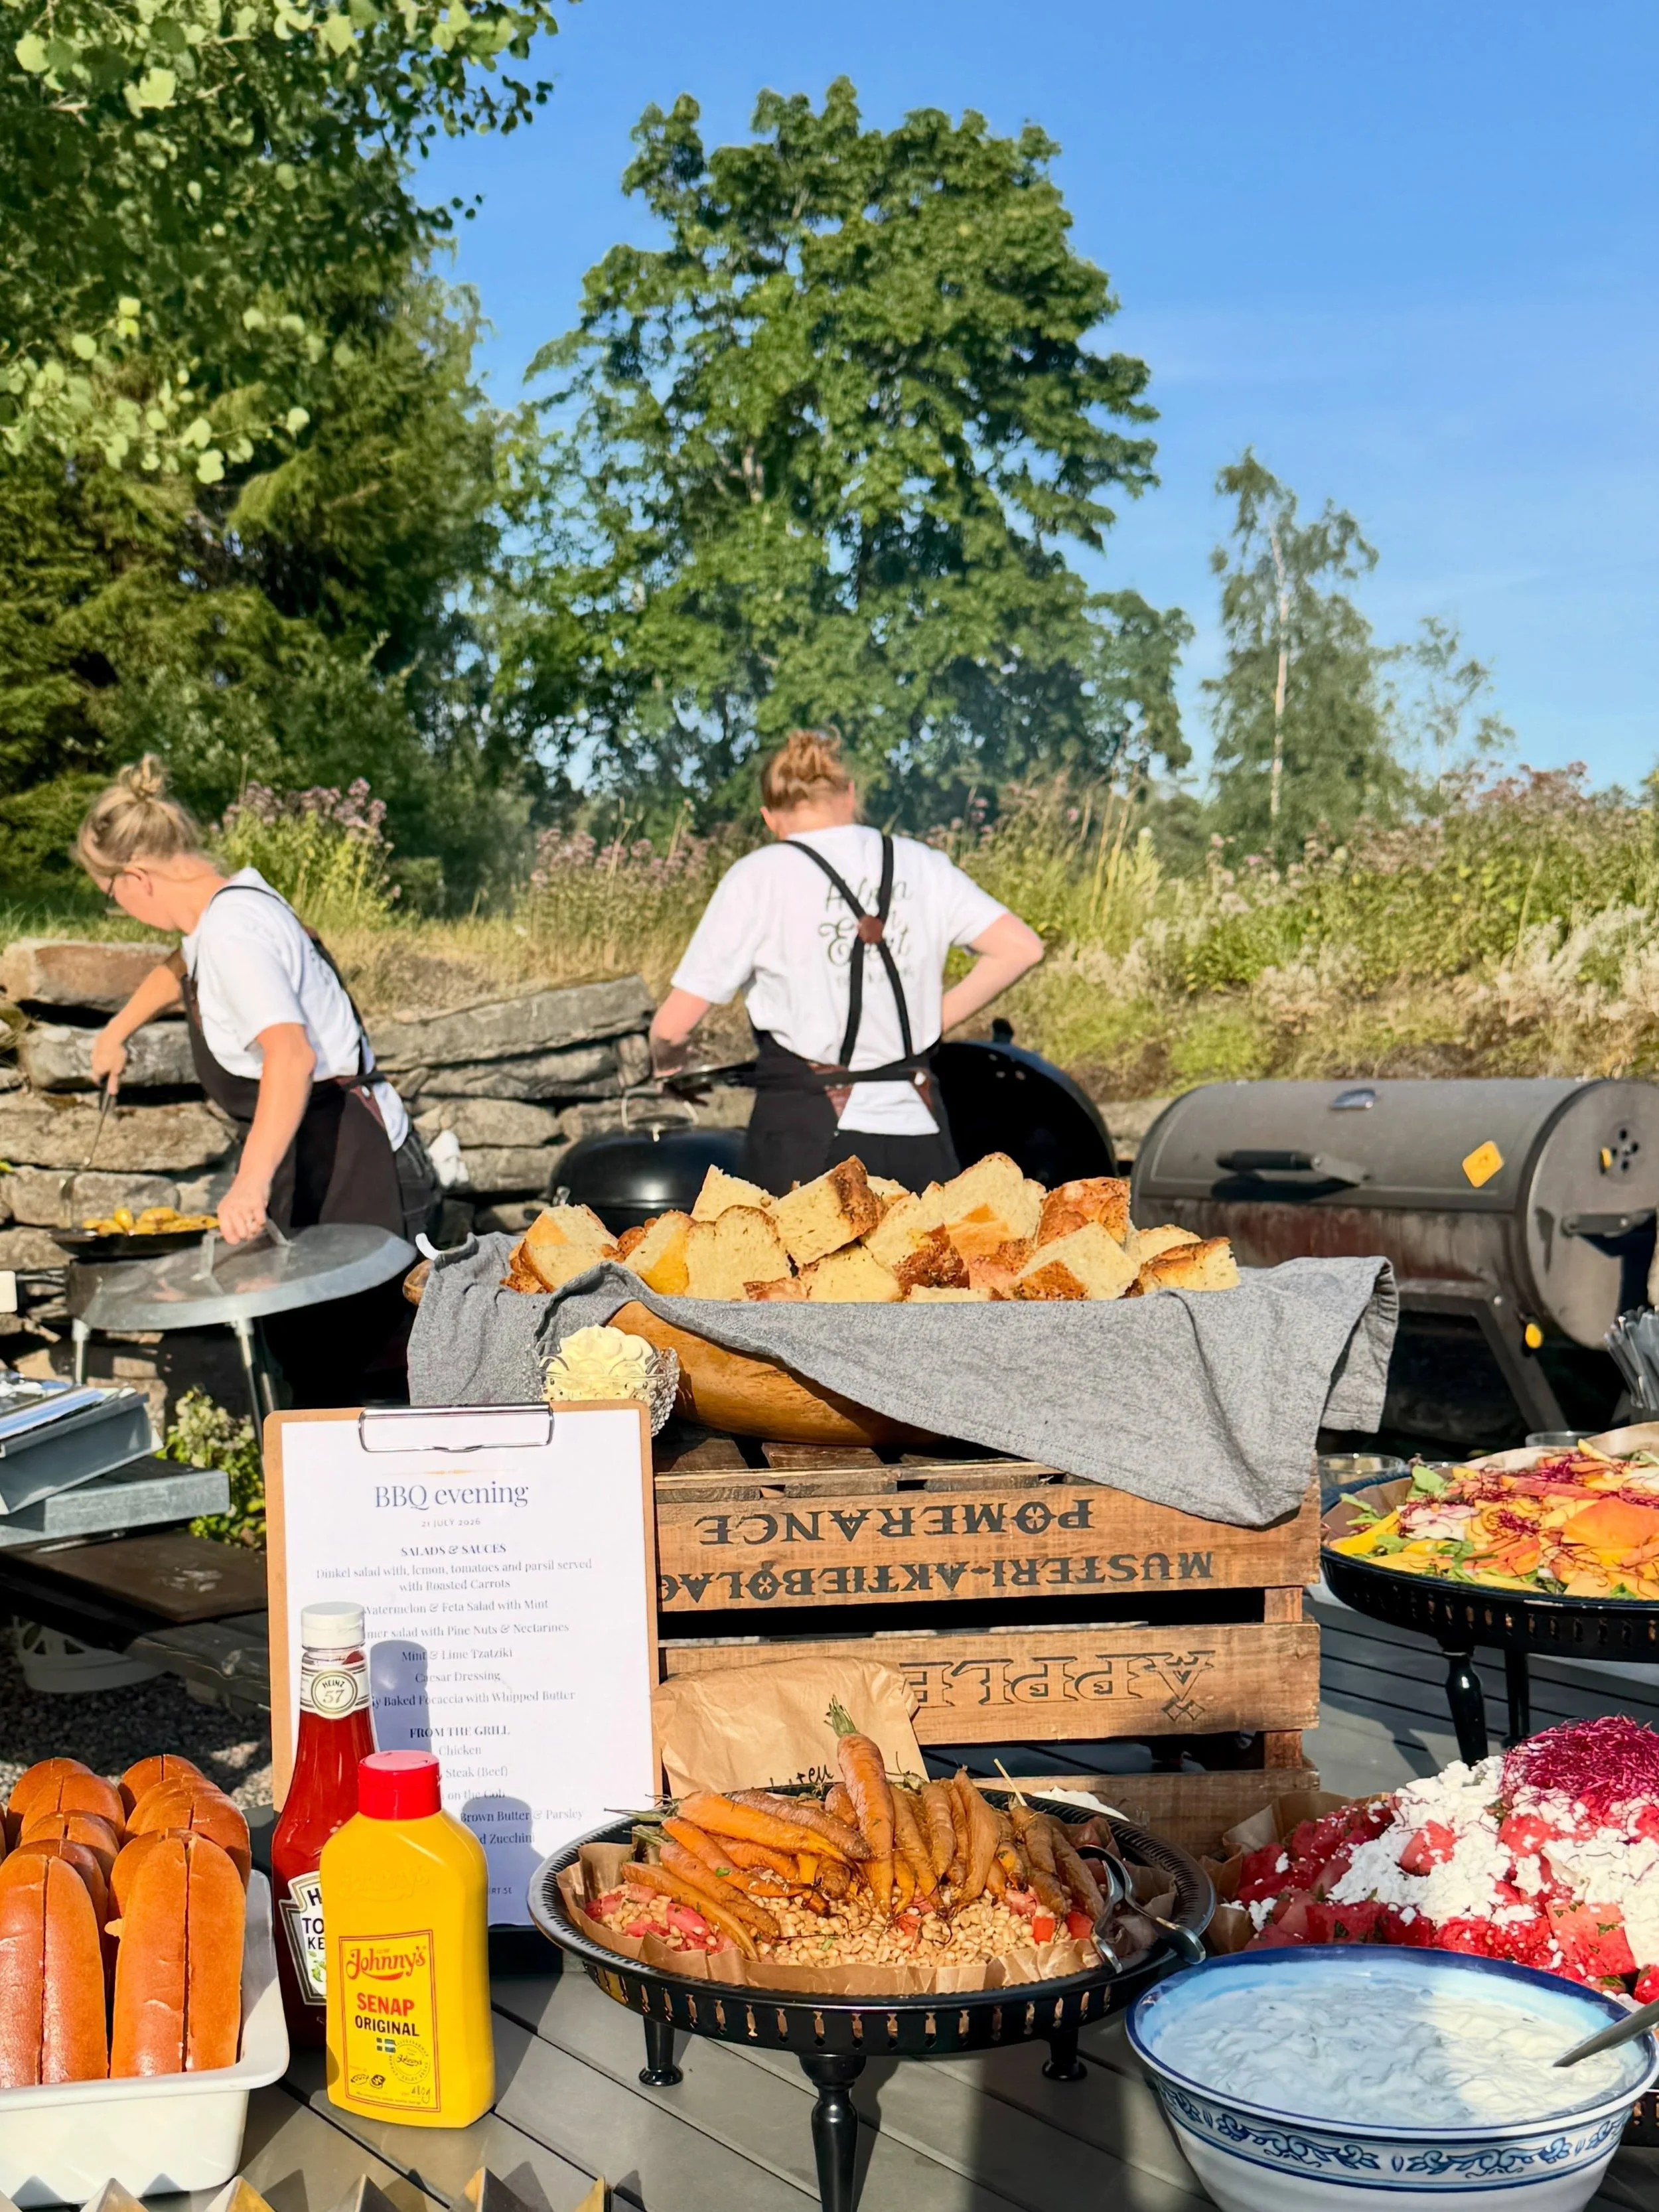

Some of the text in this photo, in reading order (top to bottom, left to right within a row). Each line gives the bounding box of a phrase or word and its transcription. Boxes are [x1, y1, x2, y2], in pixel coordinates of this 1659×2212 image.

[376, 1481, 529, 1511] BBQ evening
[433, 1518, 455, 1528] JULY
[457, 1517, 481, 1526] 2026
[693, 1498, 1096, 1546] POMERANCE
[401, 1546, 446, 1556] SALADS
[461, 1544, 506, 1554] SAUCES
[316, 1567, 350, 1579] Dinkel
[353, 1566, 380, 1578] salad
[412, 1564, 449, 1576] lemon,
[451, 1564, 500, 1574] tomatoes
[502, 1561, 522, 1572] and
[525, 1560, 555, 1574] parsil
[557, 1558, 593, 1570] served
[399, 1579, 510, 1592] with Roasted Carrots
[442, 1602, 465, 1613] Feta
[467, 1600, 495, 1611] Salad
[497, 1599, 521, 1610] with
[524, 1599, 548, 1609] Mint
[367, 1630, 388, 1639] mer
[391, 1627, 418, 1638] salad
[420, 1625, 444, 1637] with
[447, 1625, 470, 1636] Pine
[473, 1625, 498, 1635] Nuts
[513, 1623, 569, 1634] Nectarines
[401, 1651, 426, 1662] Mint
[442, 1650, 469, 1660] Lime
[470, 1647, 513, 1659] Tzatziki
[322, 1679, 345, 1689] HEINZ
[414, 1671, 501, 1684] Caesar Dressing
[323, 1688, 345, 1704] 57
[384, 1694, 416, 1707] Baked
[418, 1694, 464, 1706] Focaccia
[465, 1692, 489, 1704] with
[492, 1690, 539, 1704] Whipped
[542, 1690, 576, 1701] Butter
[409, 1725, 510, 1739] FROM THE GRILL
[438, 1743, 482, 1756] Chicken
[445, 1765, 508, 1779] Steak (Beef)
[447, 1792, 461, 1801] on
[464, 1789, 481, 1801] the
[483, 1789, 506, 1799] Cob
[461, 1812, 494, 1823] Brown
[497, 1810, 530, 1822] Butter
[546, 1808, 583, 1821] Parsley
[489, 1832, 535, 1844] Zucchini
[345, 1945, 426, 1980] Johnny's
[356, 1992, 415, 2017] SENAP
[354, 2015, 420, 2037] ORIGINAL
